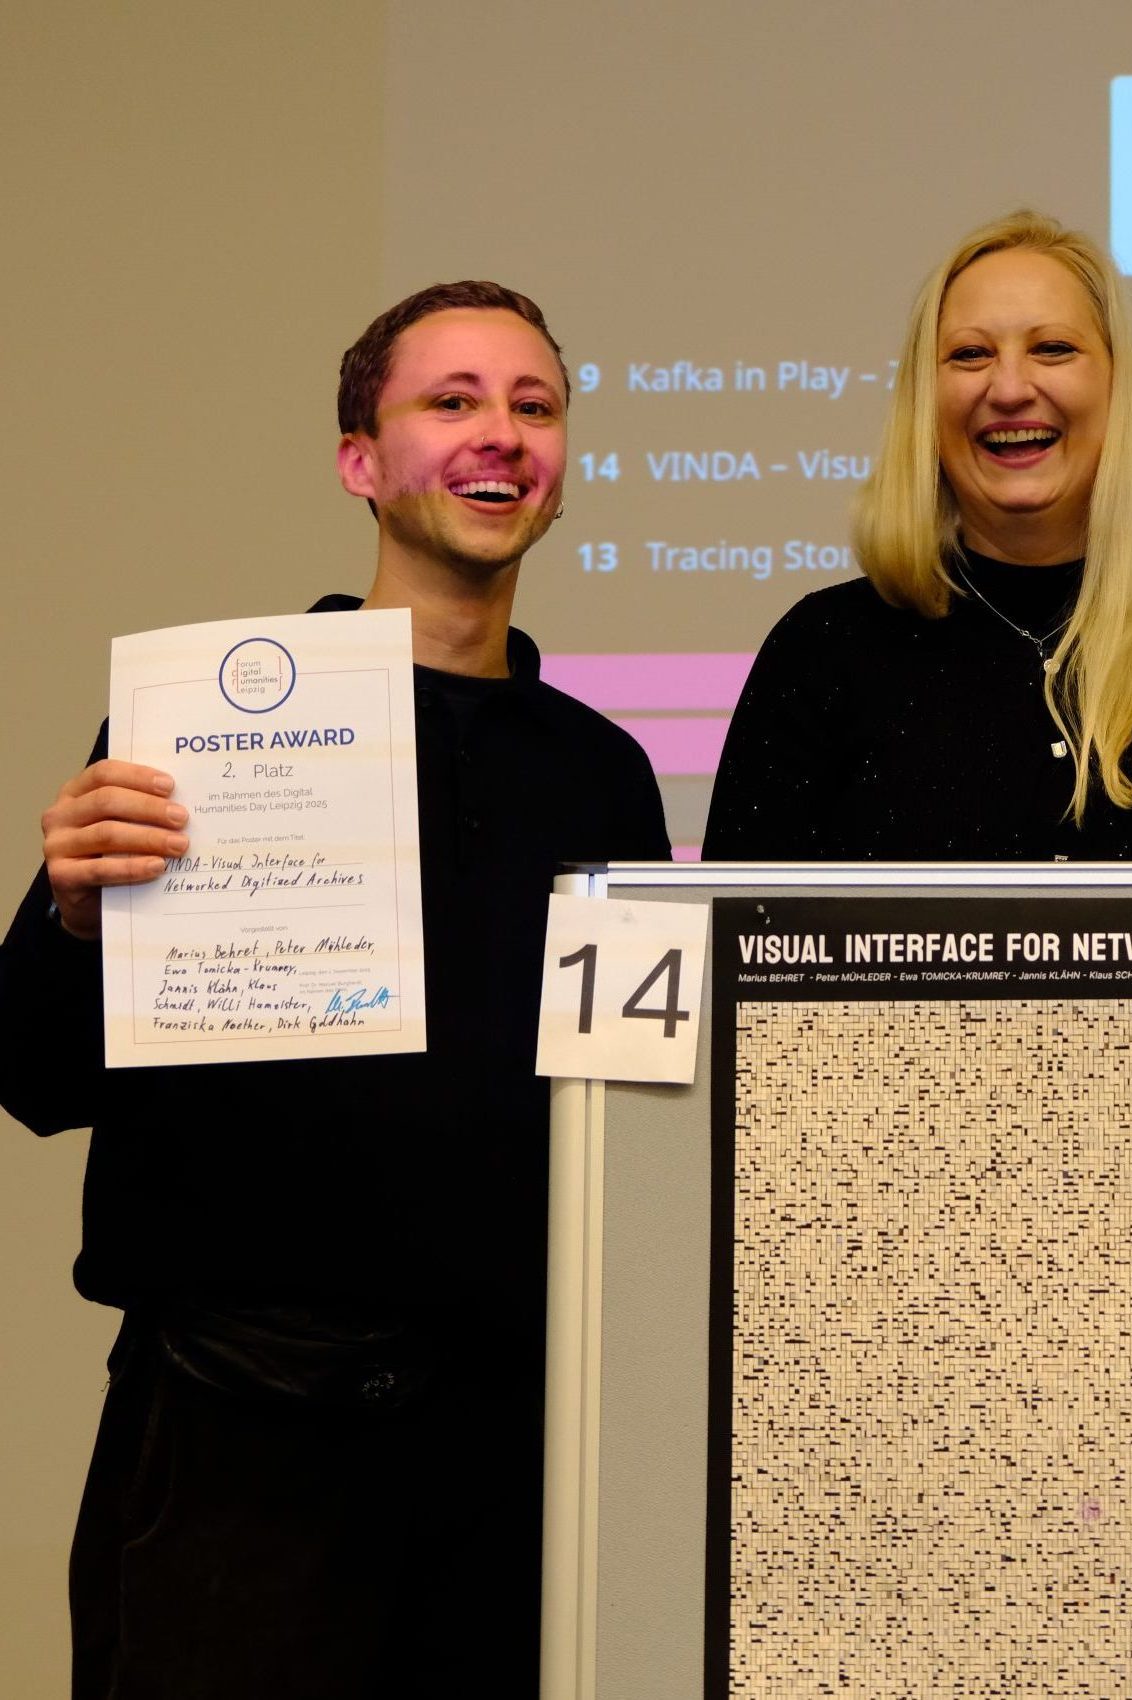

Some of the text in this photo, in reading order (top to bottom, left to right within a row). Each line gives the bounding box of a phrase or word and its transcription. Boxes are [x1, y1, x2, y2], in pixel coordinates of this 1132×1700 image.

[578, 363, 601, 393] 9
[628, 360, 724, 392] Kafka
[735, 360, 766, 391] in
[777, 361, 849, 399] Play
[580, 452, 621, 482] 14
[647, 451, 761, 482] VINDA
[578, 542, 619, 573] 13
[646, 541, 773, 580] Tracing
[175, 727, 355, 754] POSTER AWARD
[221, 761, 294, 779] 2. Platz
[193, 799, 329, 814] Humanities Day Leipzig 2025
[208, 787, 314, 801] im Rahmen des Digital
[738, 934, 834, 965] VISUAL
[845, 932, 994, 963] INTERFACE
[1006, 932, 1061, 962] FOR
[737, 973, 768, 983] Marius
[768, 972, 805, 983] BEHRET
[815, 972, 840, 982] Peter
[840, 971, 892, 982] MÜHLEDER
[899, 972, 919, 982] Ewa
[920, 971, 1011, 982] TOMICKA-KRUMREY
[1018, 971, 1047, 981] Jannis
[1048, 969, 1081, 981] KLÄHN
[1088, 970, 1113, 980] Klaus
[559, 944, 690, 1038] 14
